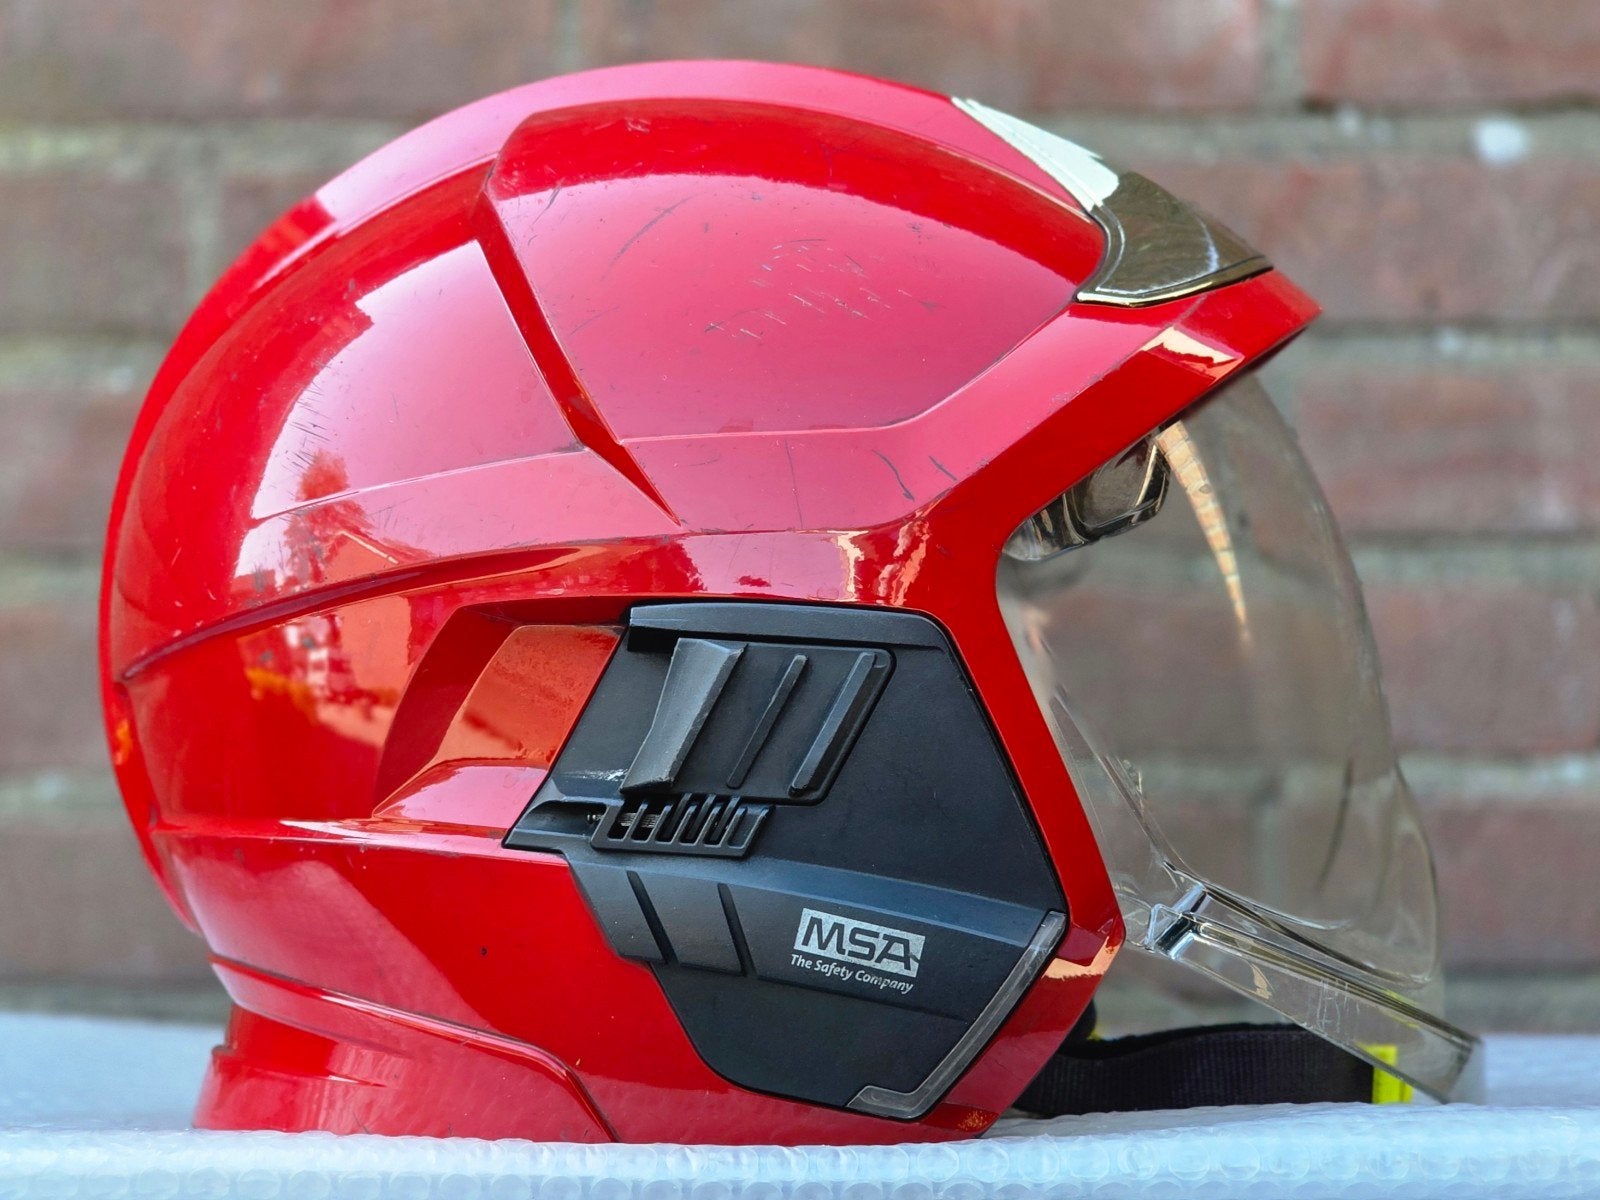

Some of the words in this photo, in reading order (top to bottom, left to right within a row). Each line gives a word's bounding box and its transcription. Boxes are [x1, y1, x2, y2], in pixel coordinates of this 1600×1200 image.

[801, 916, 912, 971] MSA
[791, 954, 812, 969] The
[814, 960, 853, 981] Safety
[855, 970, 914, 994] Company
